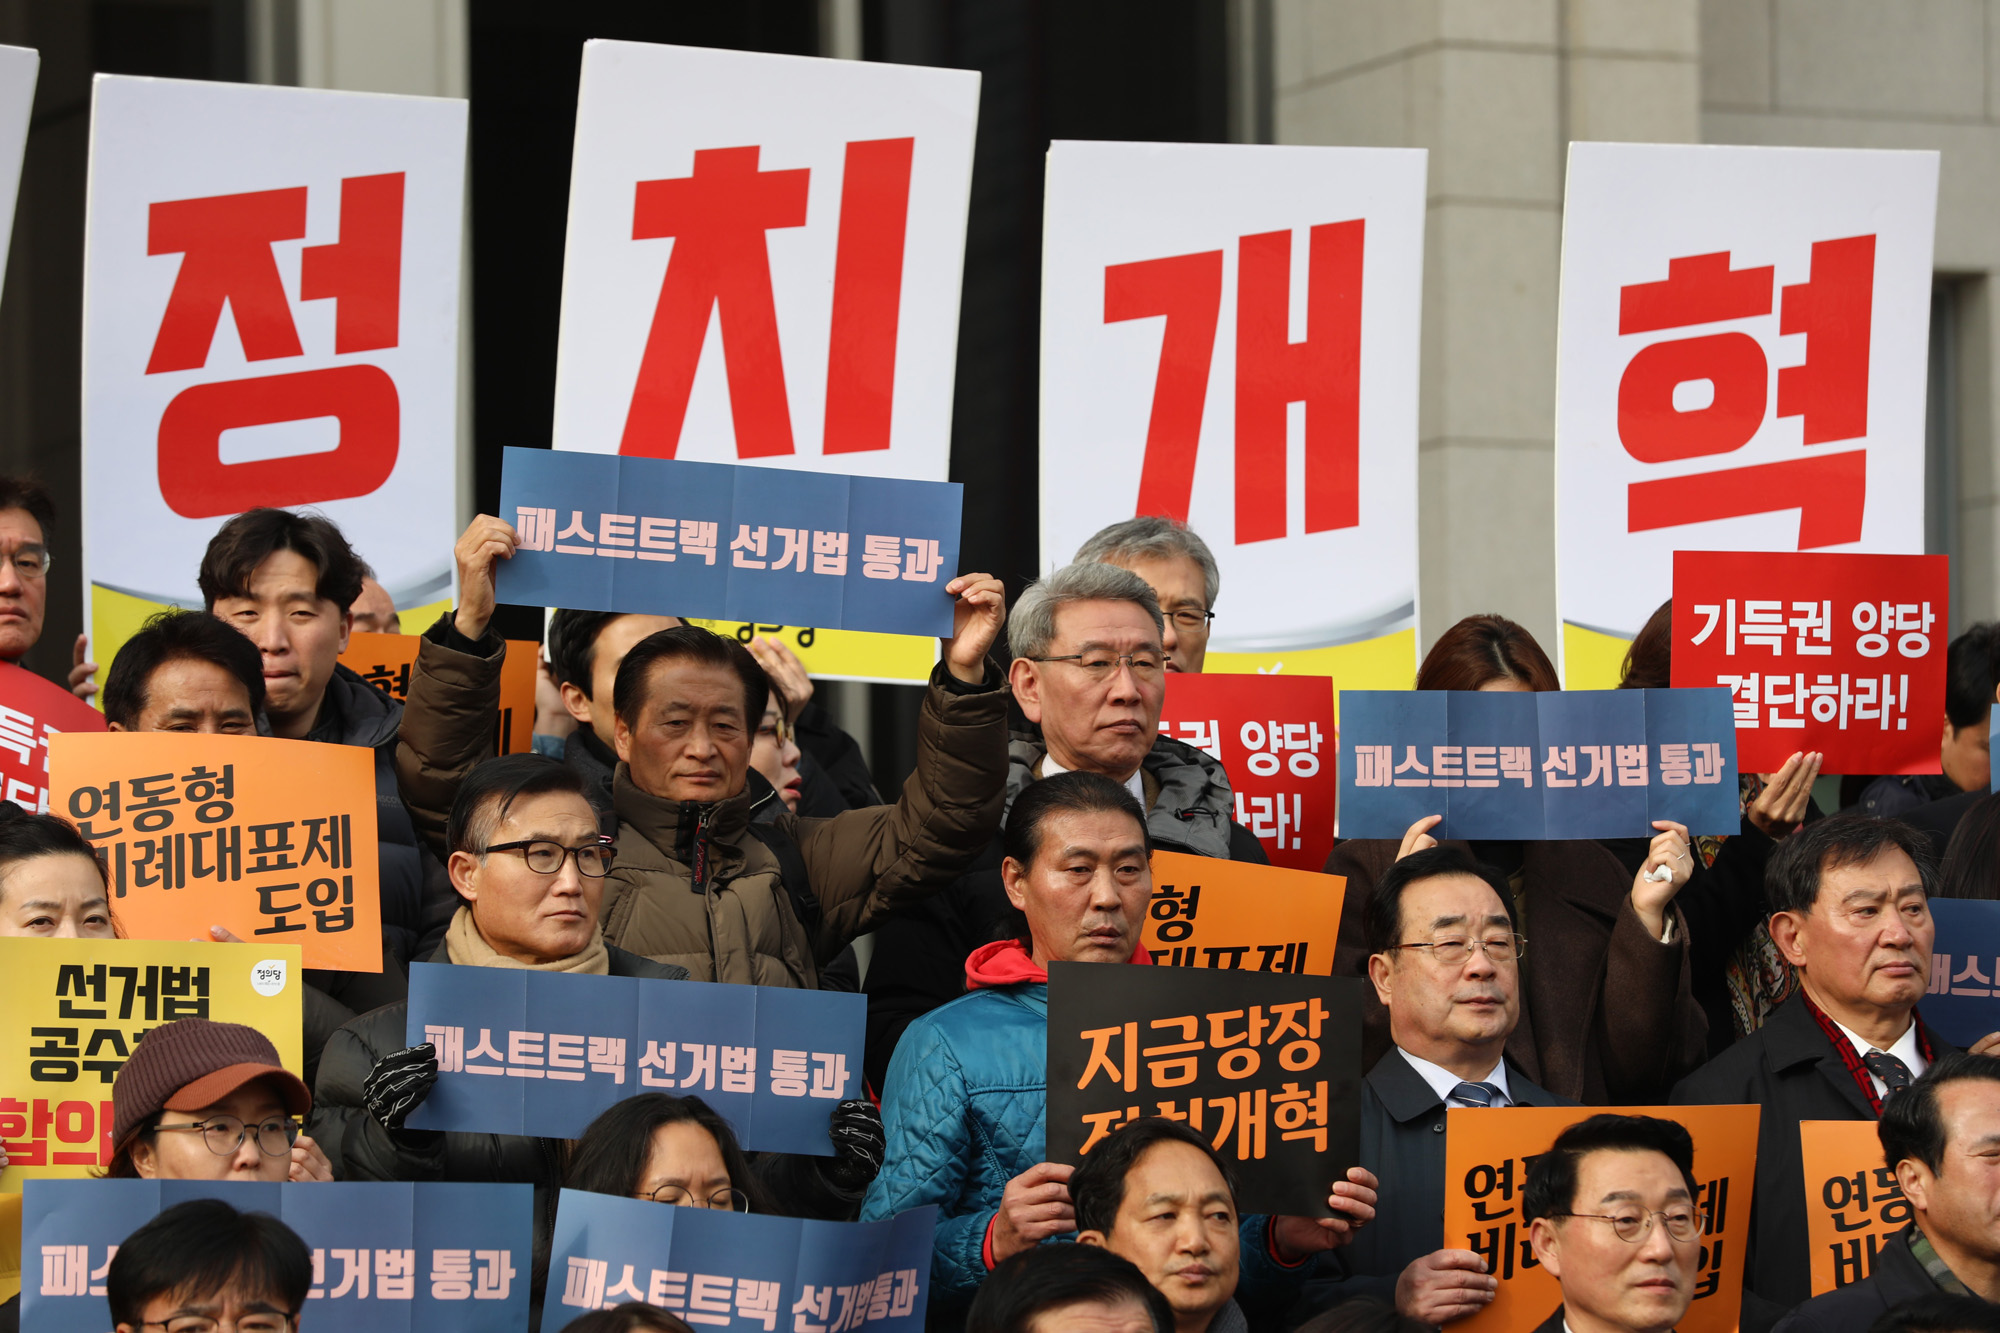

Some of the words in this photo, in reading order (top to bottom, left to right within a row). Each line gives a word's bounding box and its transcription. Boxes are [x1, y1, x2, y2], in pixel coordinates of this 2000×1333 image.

[619, 137, 915, 460] 치
[145, 171, 405, 519] 정
[1104, 218, 1365, 545] 개
[1617, 234, 1877, 551] 혁
[516, 506, 718, 565] 패스트트랙
[731, 524, 849, 576] 선거법
[862, 534, 943, 583] 통과
[1691, 599, 1832, 657] 기득권
[1851, 601, 1935, 659] 양당
[1716, 672, 1909, 731] 결단하라!
[1240, 720, 1323, 778] 양당
[1355, 744, 1533, 788] 패스트트랙
[1542, 744, 1649, 787] 선거법
[1659, 742, 1725, 786] 통과
[68, 764, 235, 840] 연동형
[254, 875, 354, 936] 도입
[1145, 885, 1201, 942] 형
[55, 964, 210, 1020] 선거법
[257, 969, 281, 980] 정의당
[30, 1027, 146, 1083] 공수
[425, 1024, 626, 1084] 패스트트랙
[638, 1040, 756, 1094] 선거법
[770, 1049, 850, 1099] 통과
[1077, 997, 1330, 1093] 지금당장
[1823, 1165, 1911, 1232] 연동
[430, 1249, 516, 1300] 통과
[562, 1256, 781, 1332] 패스트트랙
[792, 1284, 876, 1333] 선거법
[866, 1268, 919, 1321] 통과
